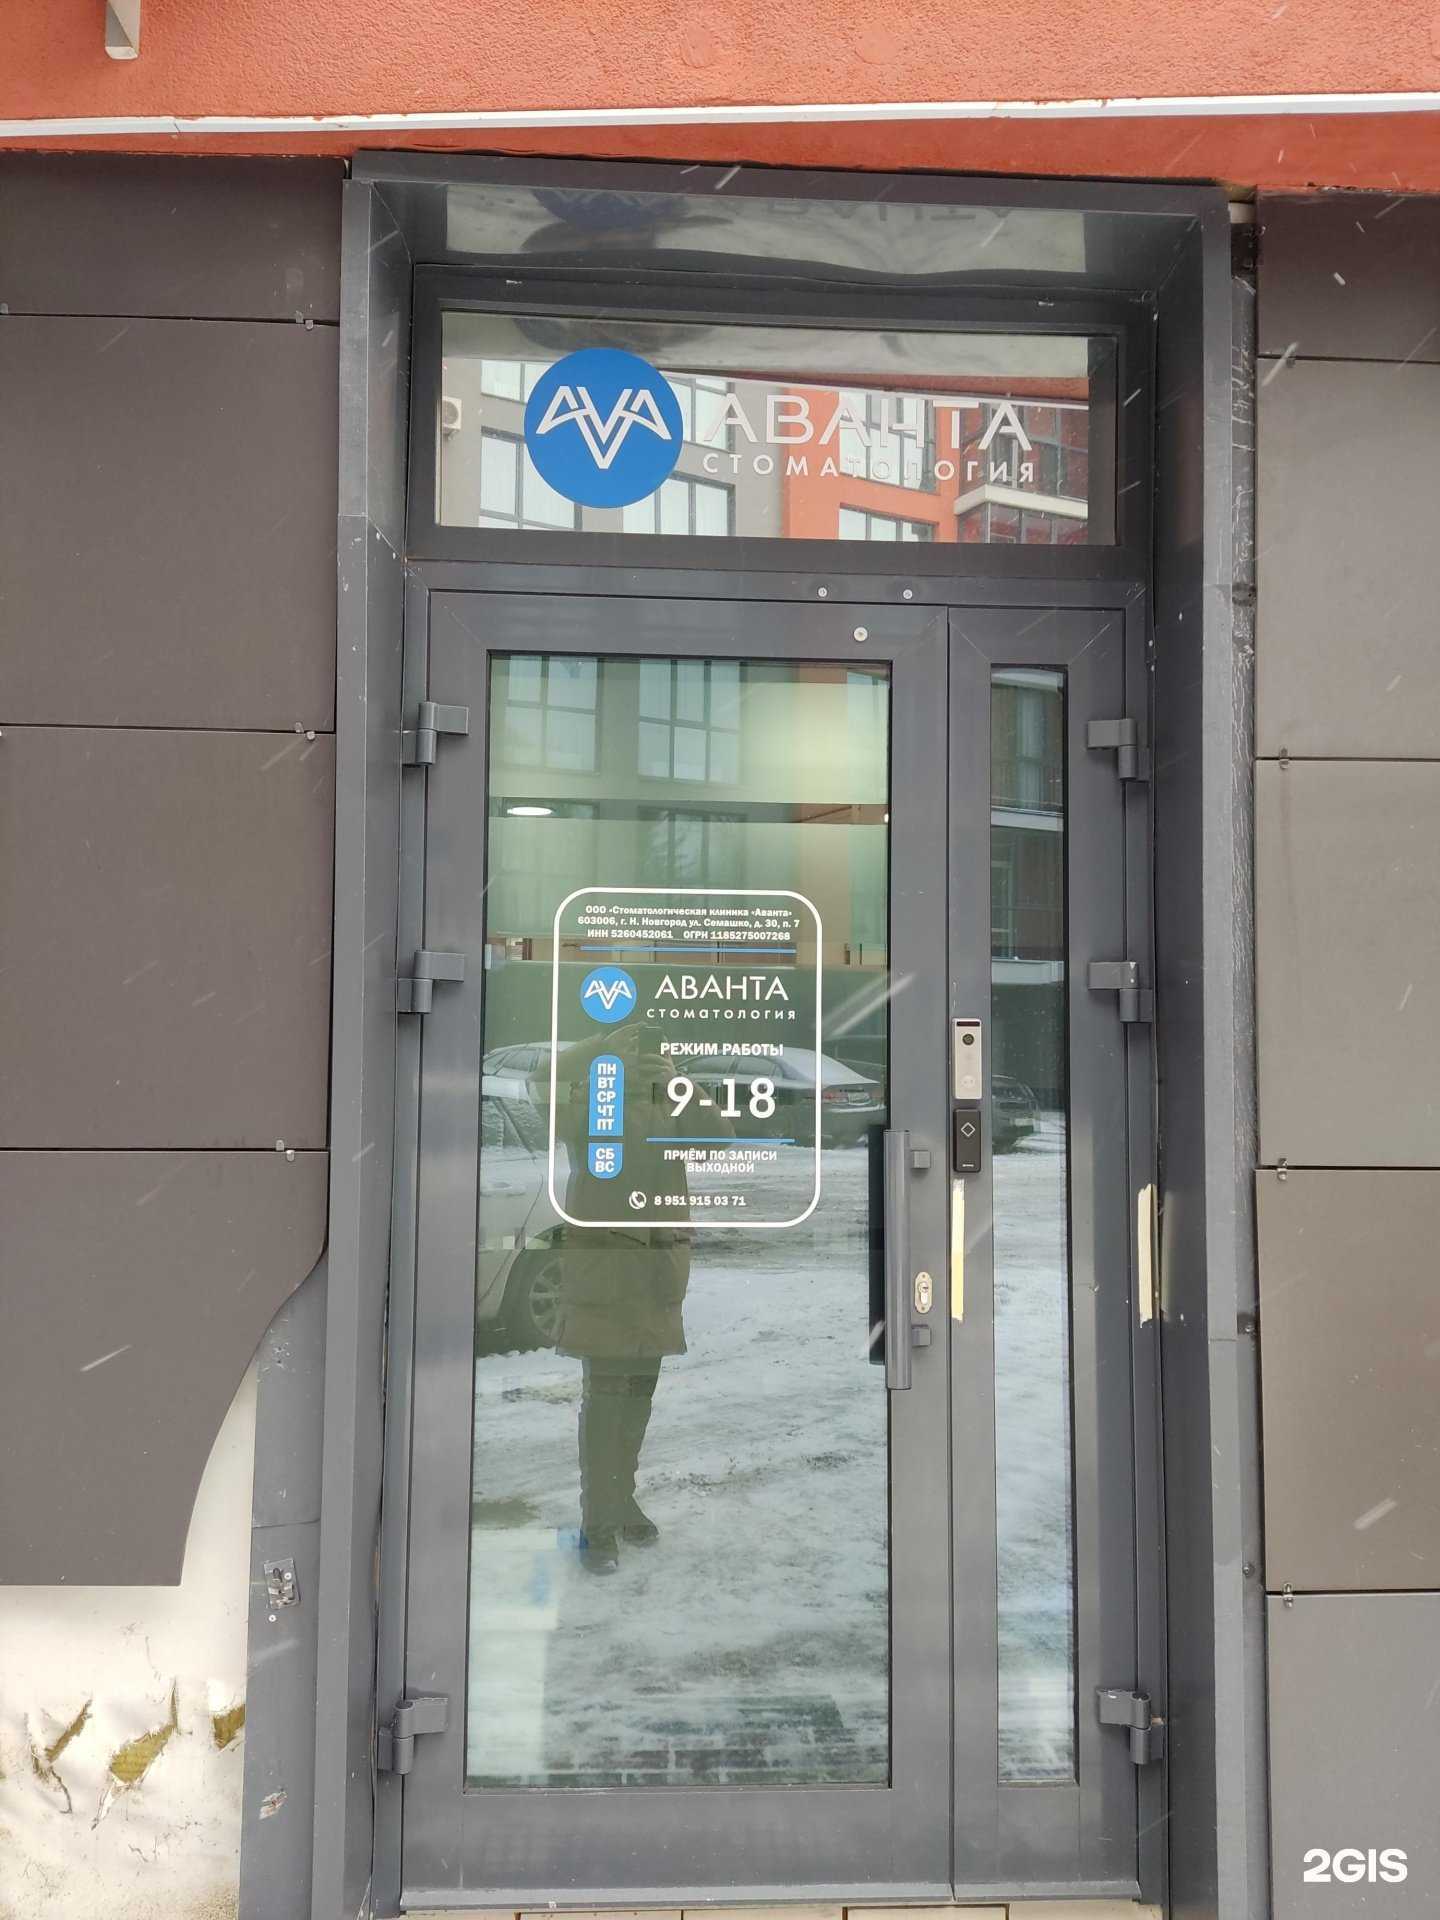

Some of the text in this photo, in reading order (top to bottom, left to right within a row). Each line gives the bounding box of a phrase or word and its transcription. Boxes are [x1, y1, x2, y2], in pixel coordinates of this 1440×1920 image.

[703, 393, 1033, 452] АВАНТА
[585, 905, 607, 914] ООО
[709, 908, 749, 916] клиника
[577, 916, 618, 926] 603006,
[620, 918, 628, 926] г.
[629, 917, 640, 926] Н.
[641, 917, 688, 928] Новгород
[689, 919, 702, 928] ул.
[754, 920, 763, 928] д.
[765, 919, 780, 929] 30,
[782, 920, 791, 928] п.
[794, 919, 800, 928] 7
[587, 929, 609, 938] ИНН
[610, 929, 674, 939] 5260452061
[683, 930, 708, 939] ОГРН
[655, 974, 789, 1001] АВАНТА
[660, 1042, 784, 1057] РЕЖИМ РАБОТЫ
[597, 1063, 617, 1075] ПН
[597, 1077, 616, 1089] ВТ
[596, 1091, 616, 1104] СР
[667, 1076, 776, 1119] 9-18
[597, 1105, 615, 1117] ЧТ
[596, 1118, 615, 1131] ПТ
[595, 1148, 615, 1160] СБ
[664, 1148, 777, 1161] ПРИЁМ ПО ЗАПИСИ
[595, 1161, 615, 1173] ВС
[687, 1161, 754, 1174] ВЫХОДНОЙ
[654, 1196, 746, 1206] 8 951 915 03 71
